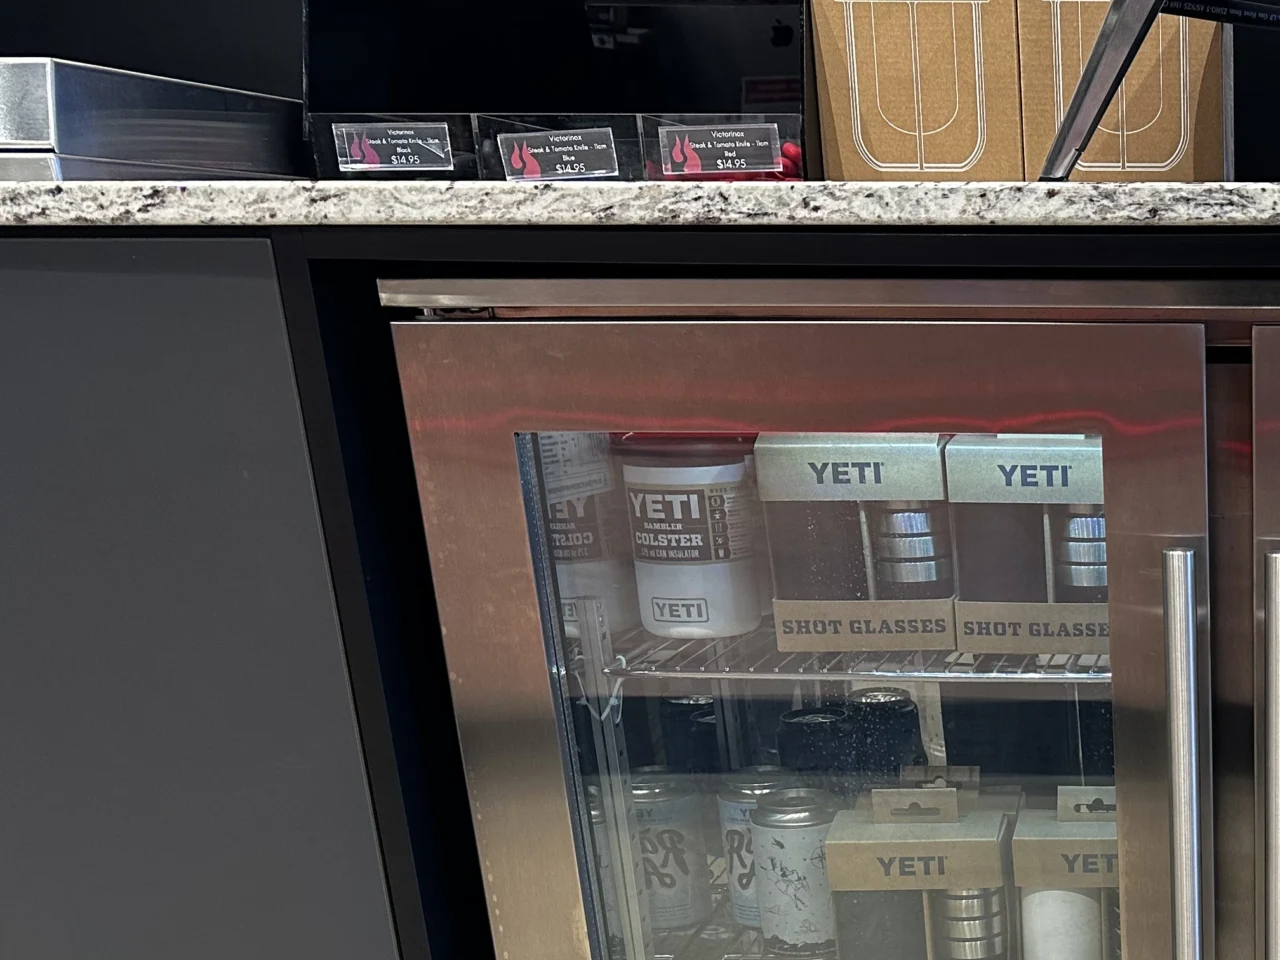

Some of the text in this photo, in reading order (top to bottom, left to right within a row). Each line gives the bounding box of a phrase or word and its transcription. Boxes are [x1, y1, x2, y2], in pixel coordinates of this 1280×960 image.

[711, 130, 745, 138] Victorinox
[551, 145, 573, 153] Tomato
[391, 155, 420, 165] $14.95
[717, 159, 746, 169] $14.95
[555, 163, 586, 174] $14.95
[808, 462, 882, 484] YETI
[997, 464, 1071, 487] YETI
[630, 492, 700, 519] YETI
[644, 522, 683, 530] RAMBLER
[635, 532, 703, 546] COLSTER
[656, 549, 667, 557] CAN
[668, 549, 699, 558] INSULATOR
[656, 602, 702, 618] YETI
[782, 618, 947, 636] SHOT GLASSES
[964, 621, 1022, 637] SHOT
[876, 856, 943, 877] YETI
